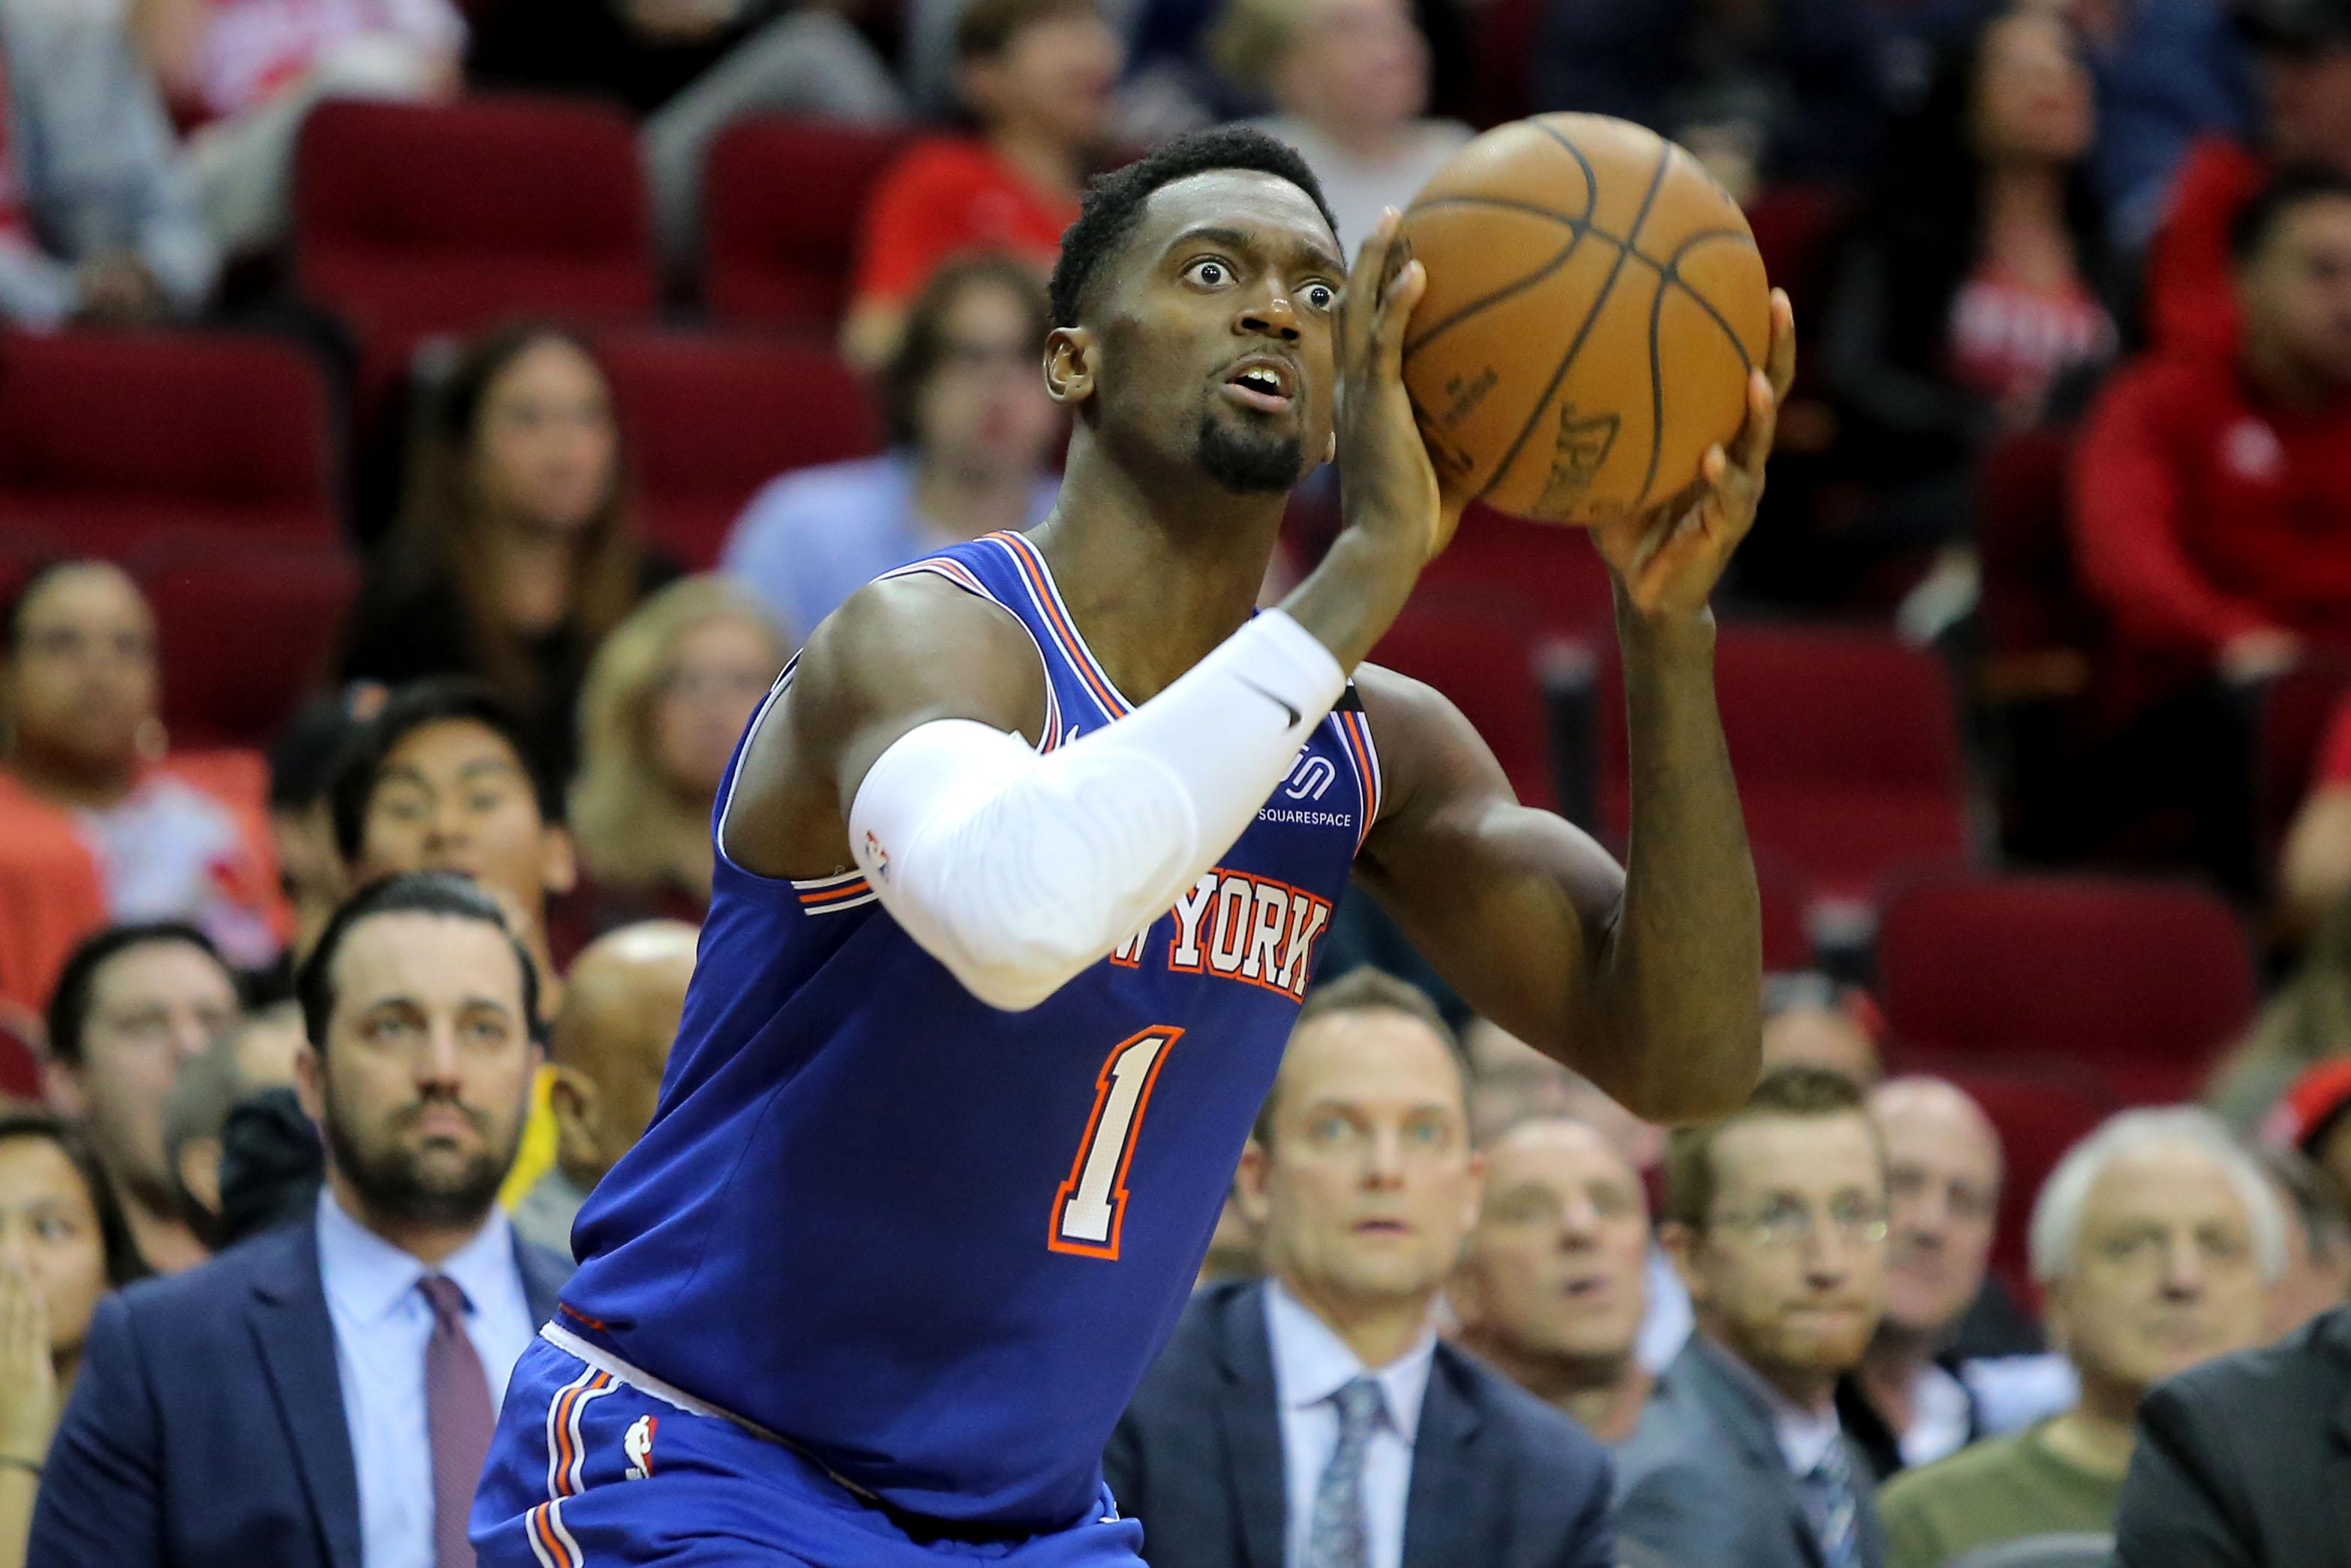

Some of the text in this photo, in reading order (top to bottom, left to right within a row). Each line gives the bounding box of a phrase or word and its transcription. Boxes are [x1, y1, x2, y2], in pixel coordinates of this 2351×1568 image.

[1258, 808, 1351, 827] SQUARESPACE
[1168, 866, 1333, 1005] YORK
[1048, 1024, 1186, 1261] 1
